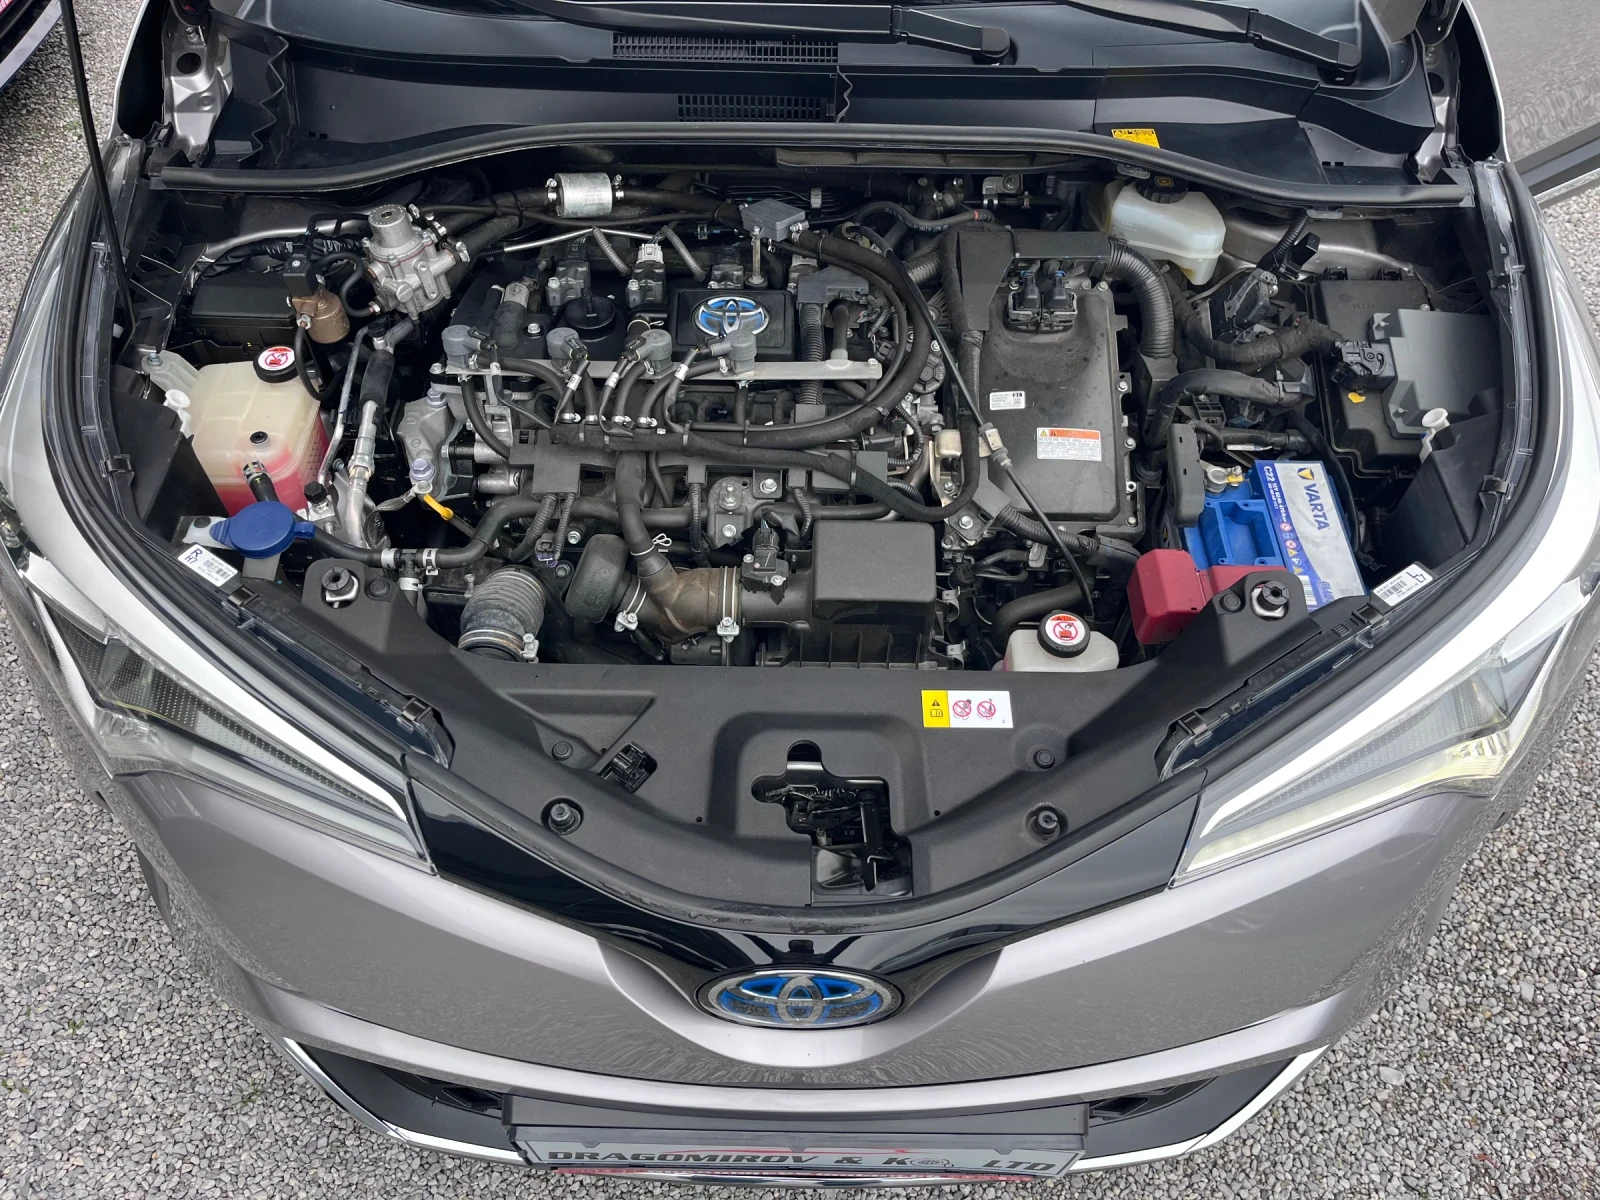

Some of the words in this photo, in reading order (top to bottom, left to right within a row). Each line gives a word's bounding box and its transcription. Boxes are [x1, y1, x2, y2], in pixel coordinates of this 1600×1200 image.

[1264, 466, 1275, 481] C22
[1304, 483, 1330, 530] VARTA
[548, 1151, 818, 1164] DRAGOMIROV
[834, 1156, 862, 1164] &
[982, 1159, 1056, 1171] LTD
